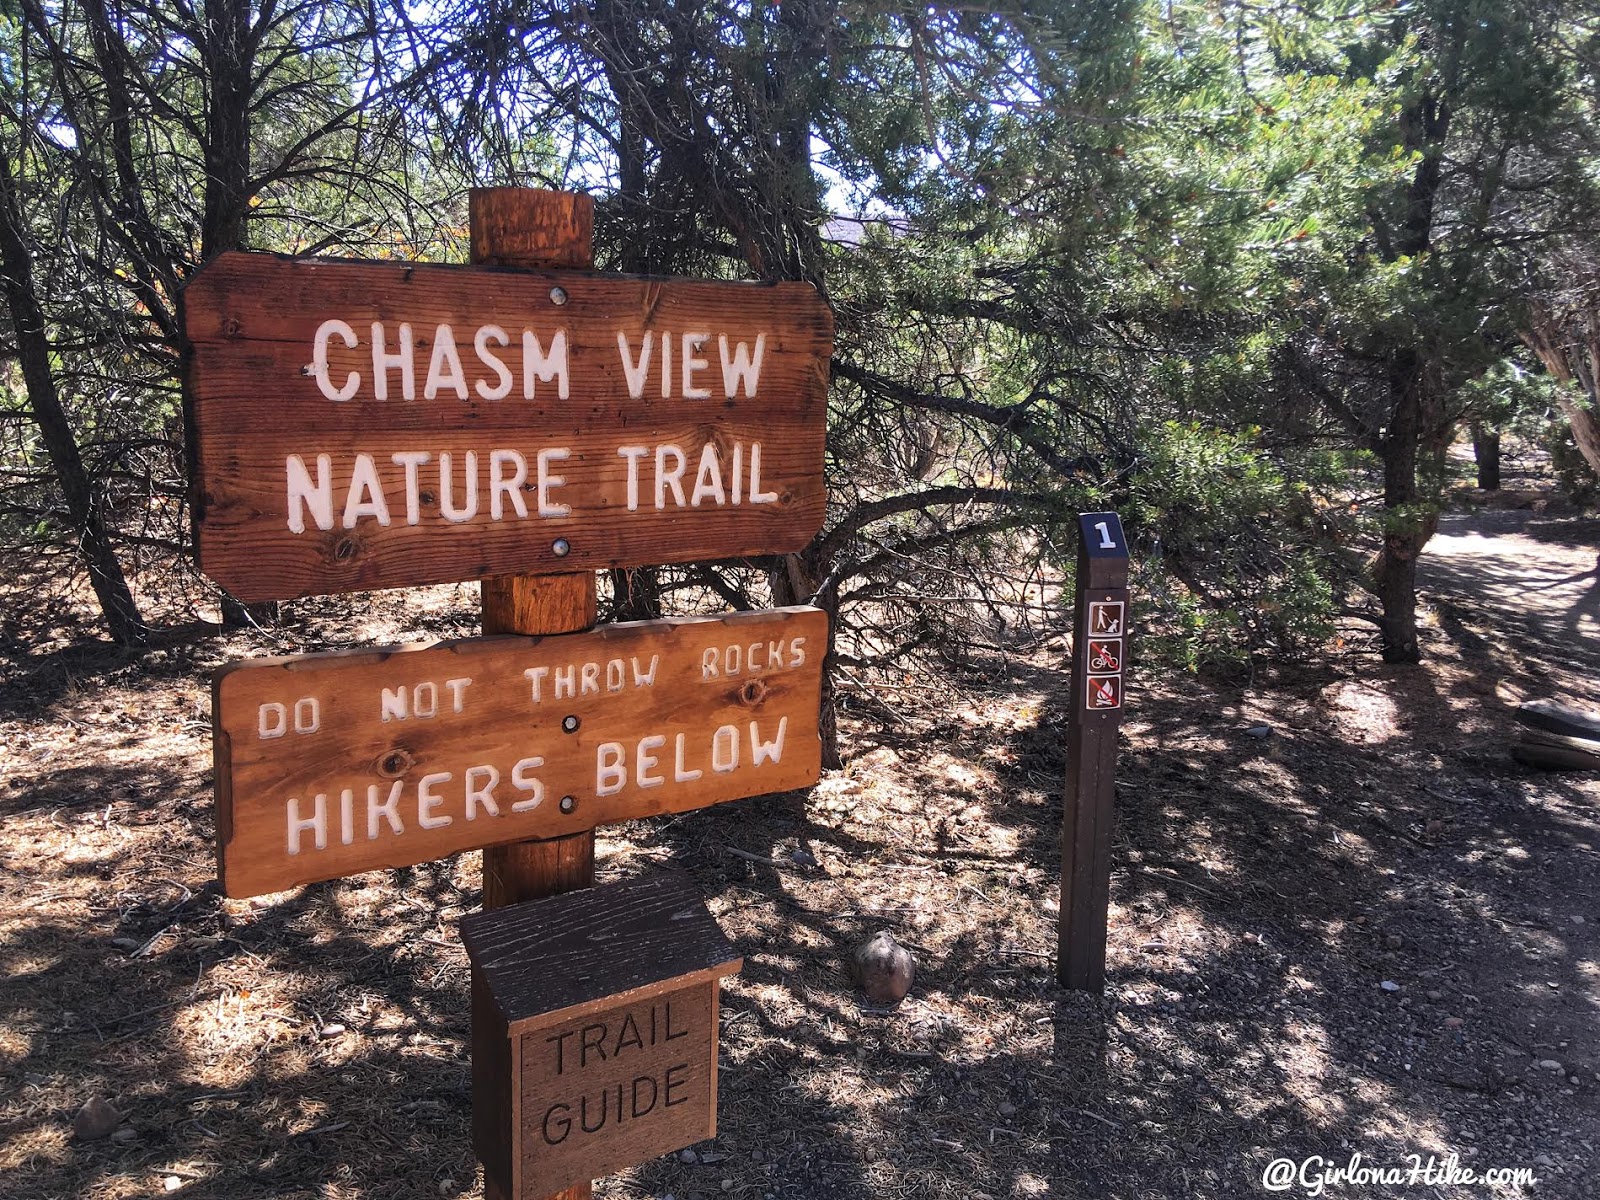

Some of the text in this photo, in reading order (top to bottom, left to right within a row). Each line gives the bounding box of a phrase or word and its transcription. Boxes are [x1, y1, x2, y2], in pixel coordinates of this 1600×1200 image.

[312, 319, 767, 402] CHASM VIEW
[286, 441, 780, 534] NATURE TRAIL
[1094, 521, 1117, 549] 1
[257, 637, 807, 740] DO NOT THROW ROCKS
[286, 716, 788, 856] HIKERS BELOW
[546, 1001, 688, 1075] TRAIL
[542, 1063, 688, 1146] GUIDE
